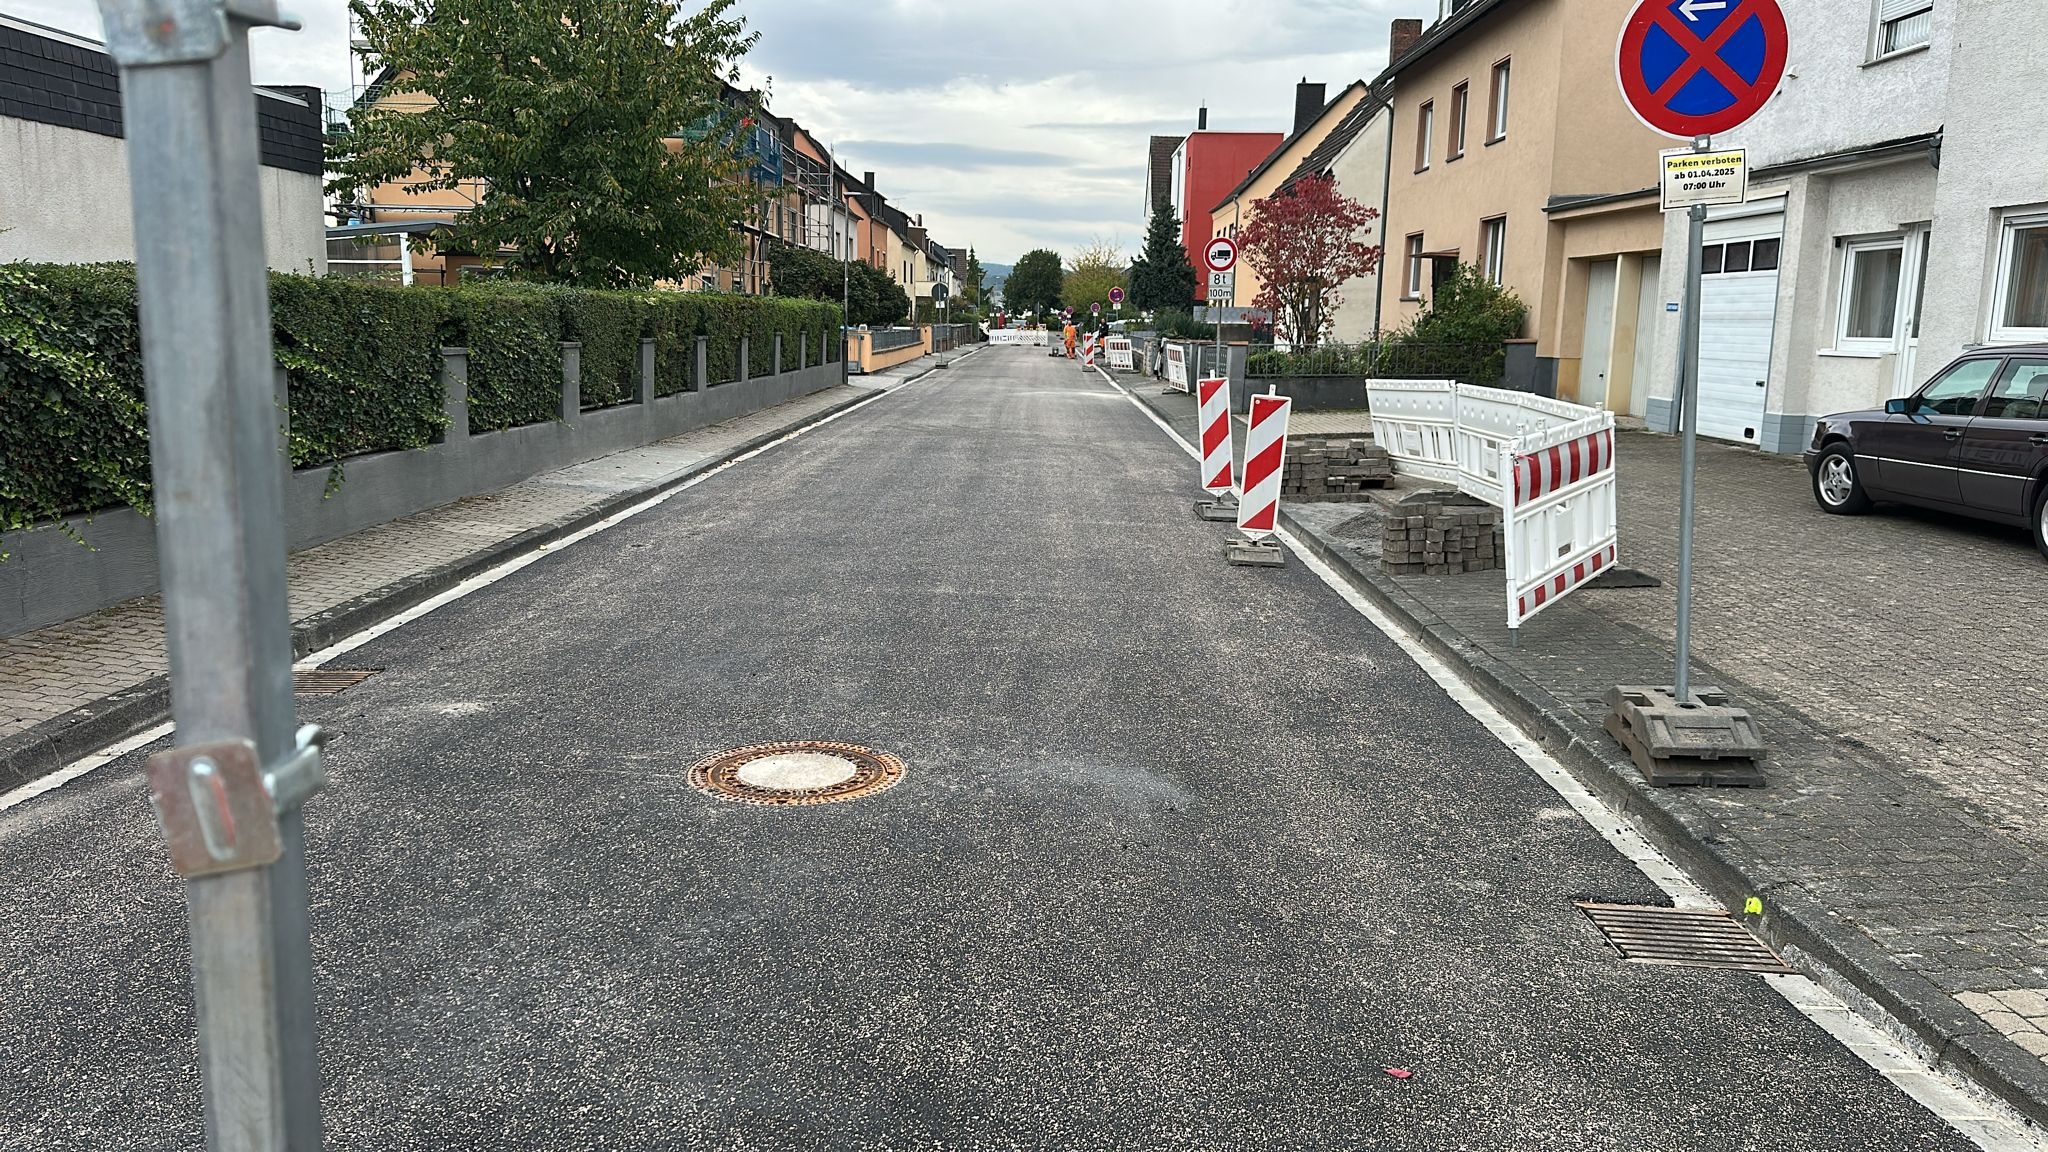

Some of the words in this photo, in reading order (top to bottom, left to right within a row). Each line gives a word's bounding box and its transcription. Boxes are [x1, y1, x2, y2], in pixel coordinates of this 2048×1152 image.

[1667, 159, 1699, 169] Parken
[1701, 156, 1742, 166] verboten
[1674, 171, 1685, 179] ab
[1687, 168, 1735, 178] 01.04.2025
[1683, 182, 1707, 191] 07:00
[1709, 180, 1726, 189] Uhr
